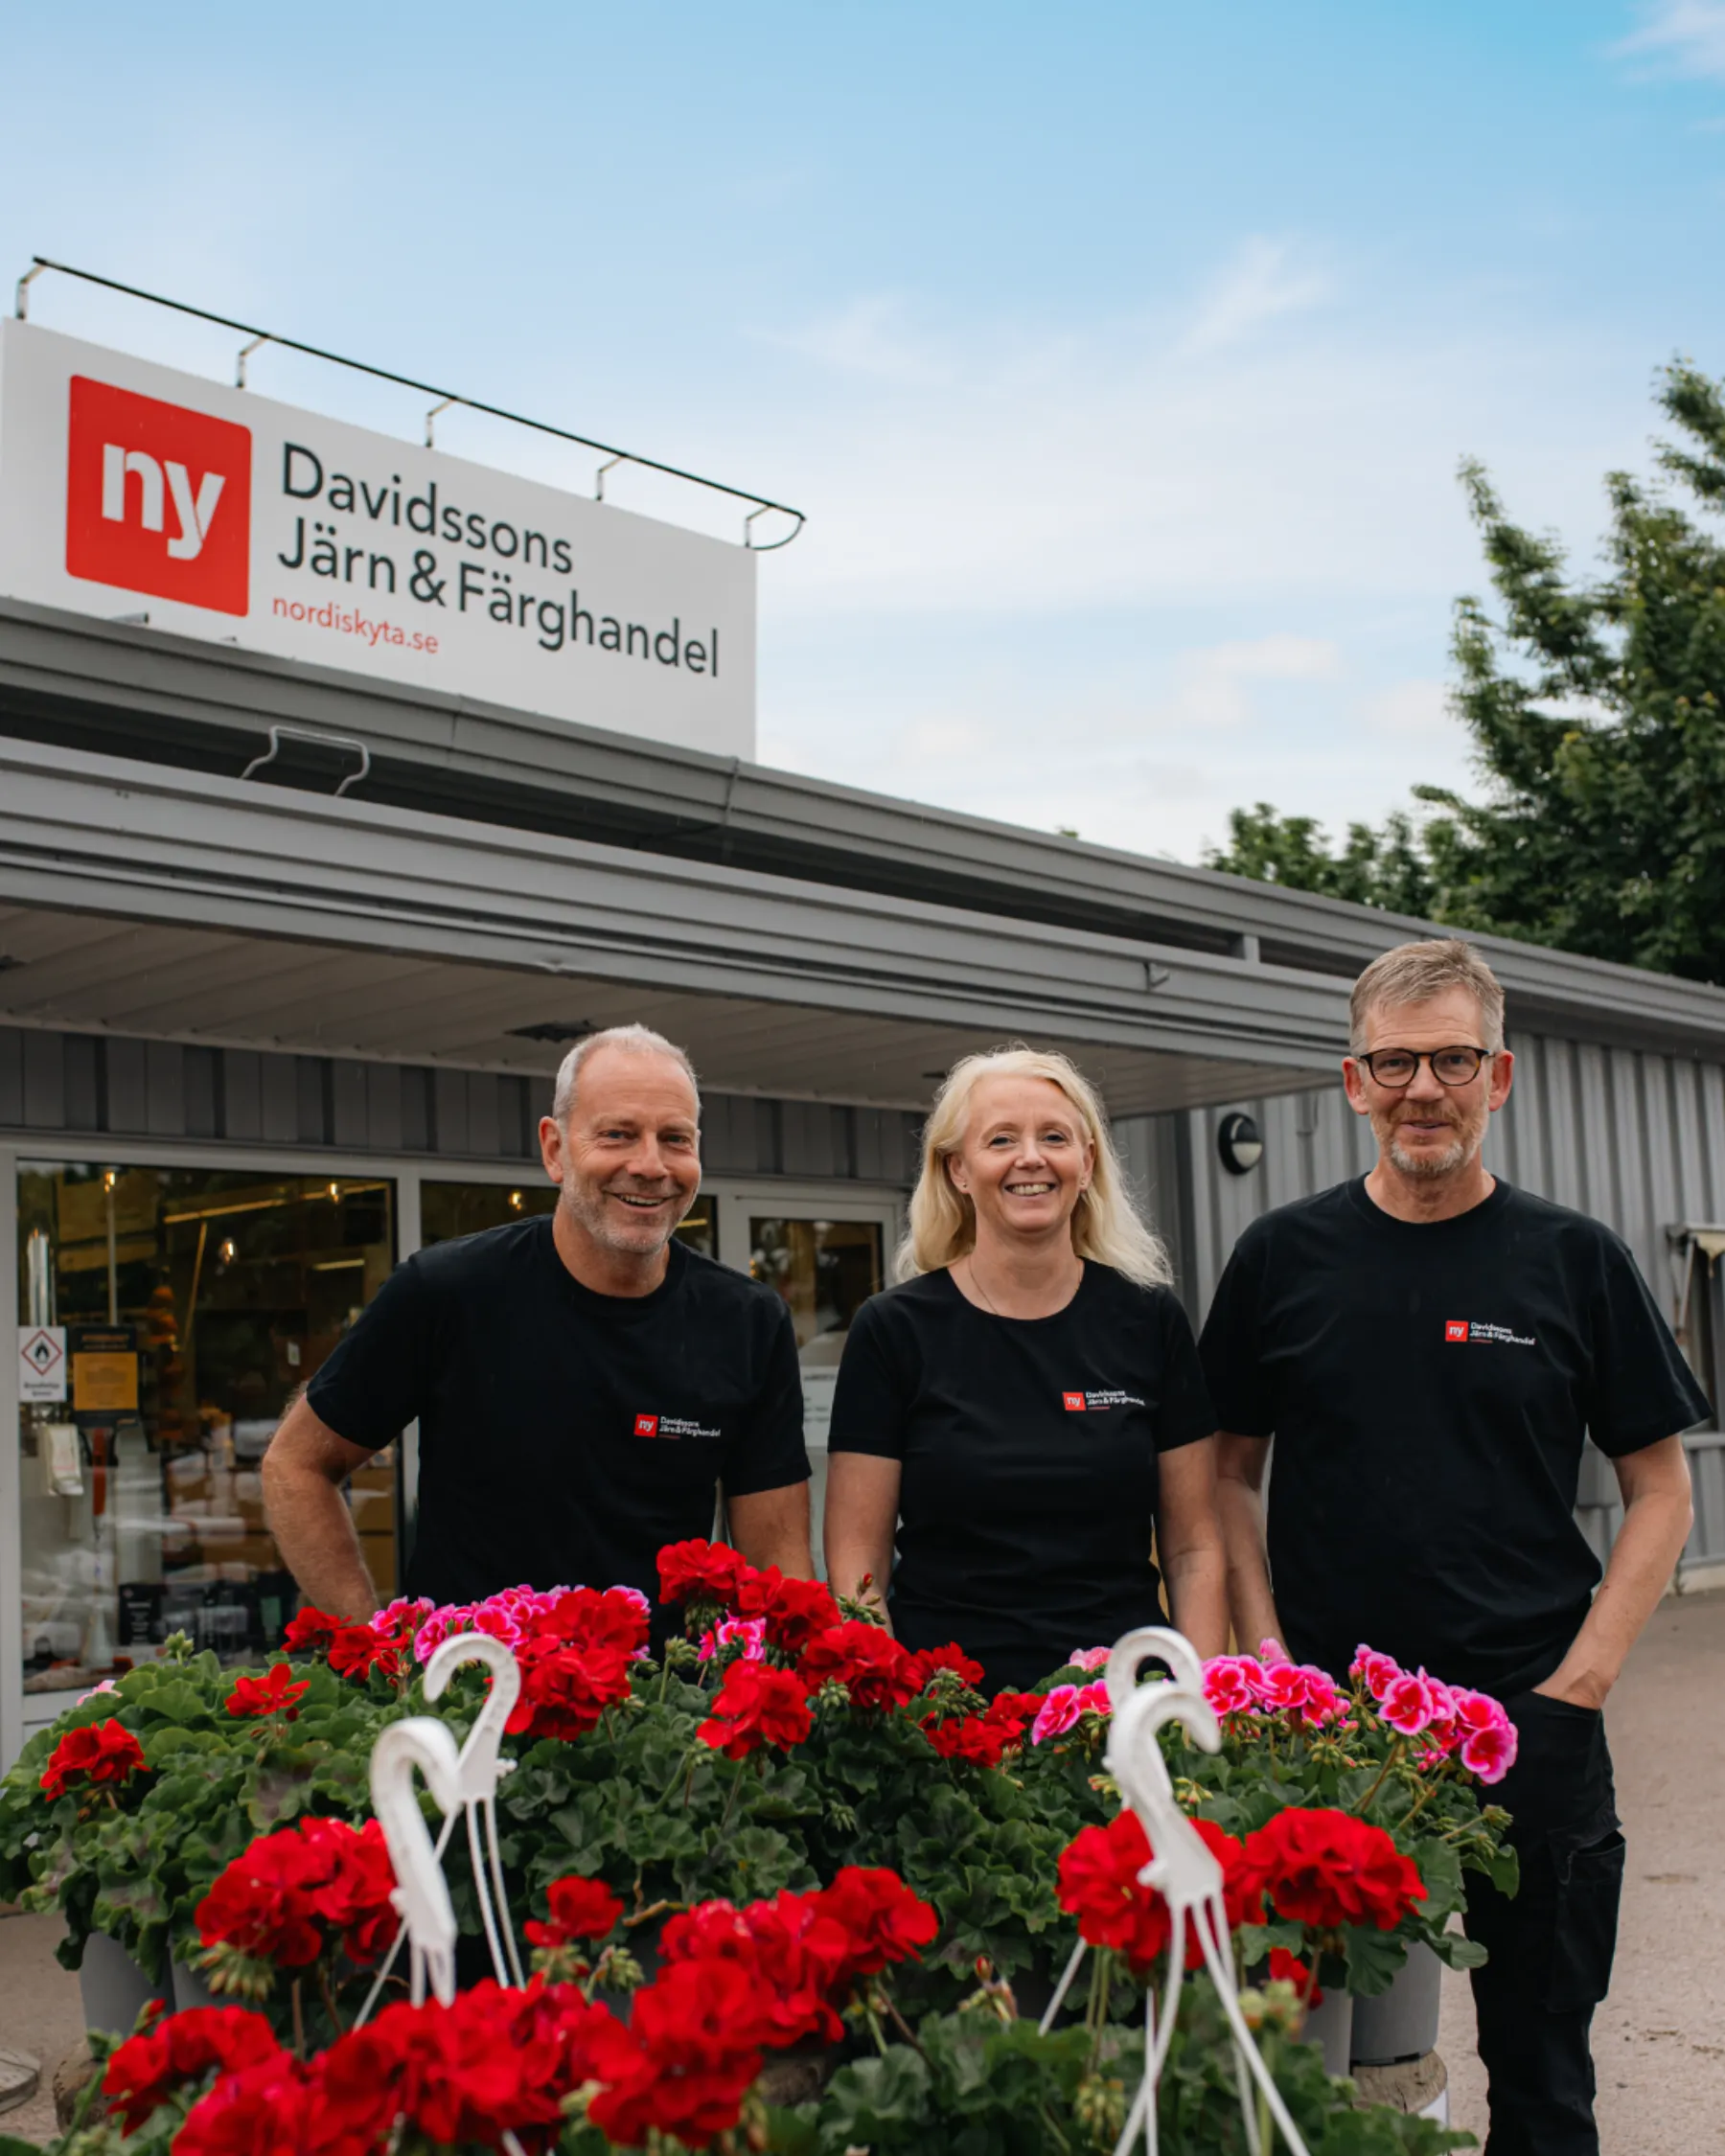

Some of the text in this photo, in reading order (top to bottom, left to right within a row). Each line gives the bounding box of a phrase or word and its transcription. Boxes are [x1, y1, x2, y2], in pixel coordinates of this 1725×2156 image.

[102, 443, 226, 561] ny
[283, 441, 573, 575] Davidssons
[272, 595, 440, 654] nordiskyta.se
[277, 516, 719, 677] Järn & Färghandel
